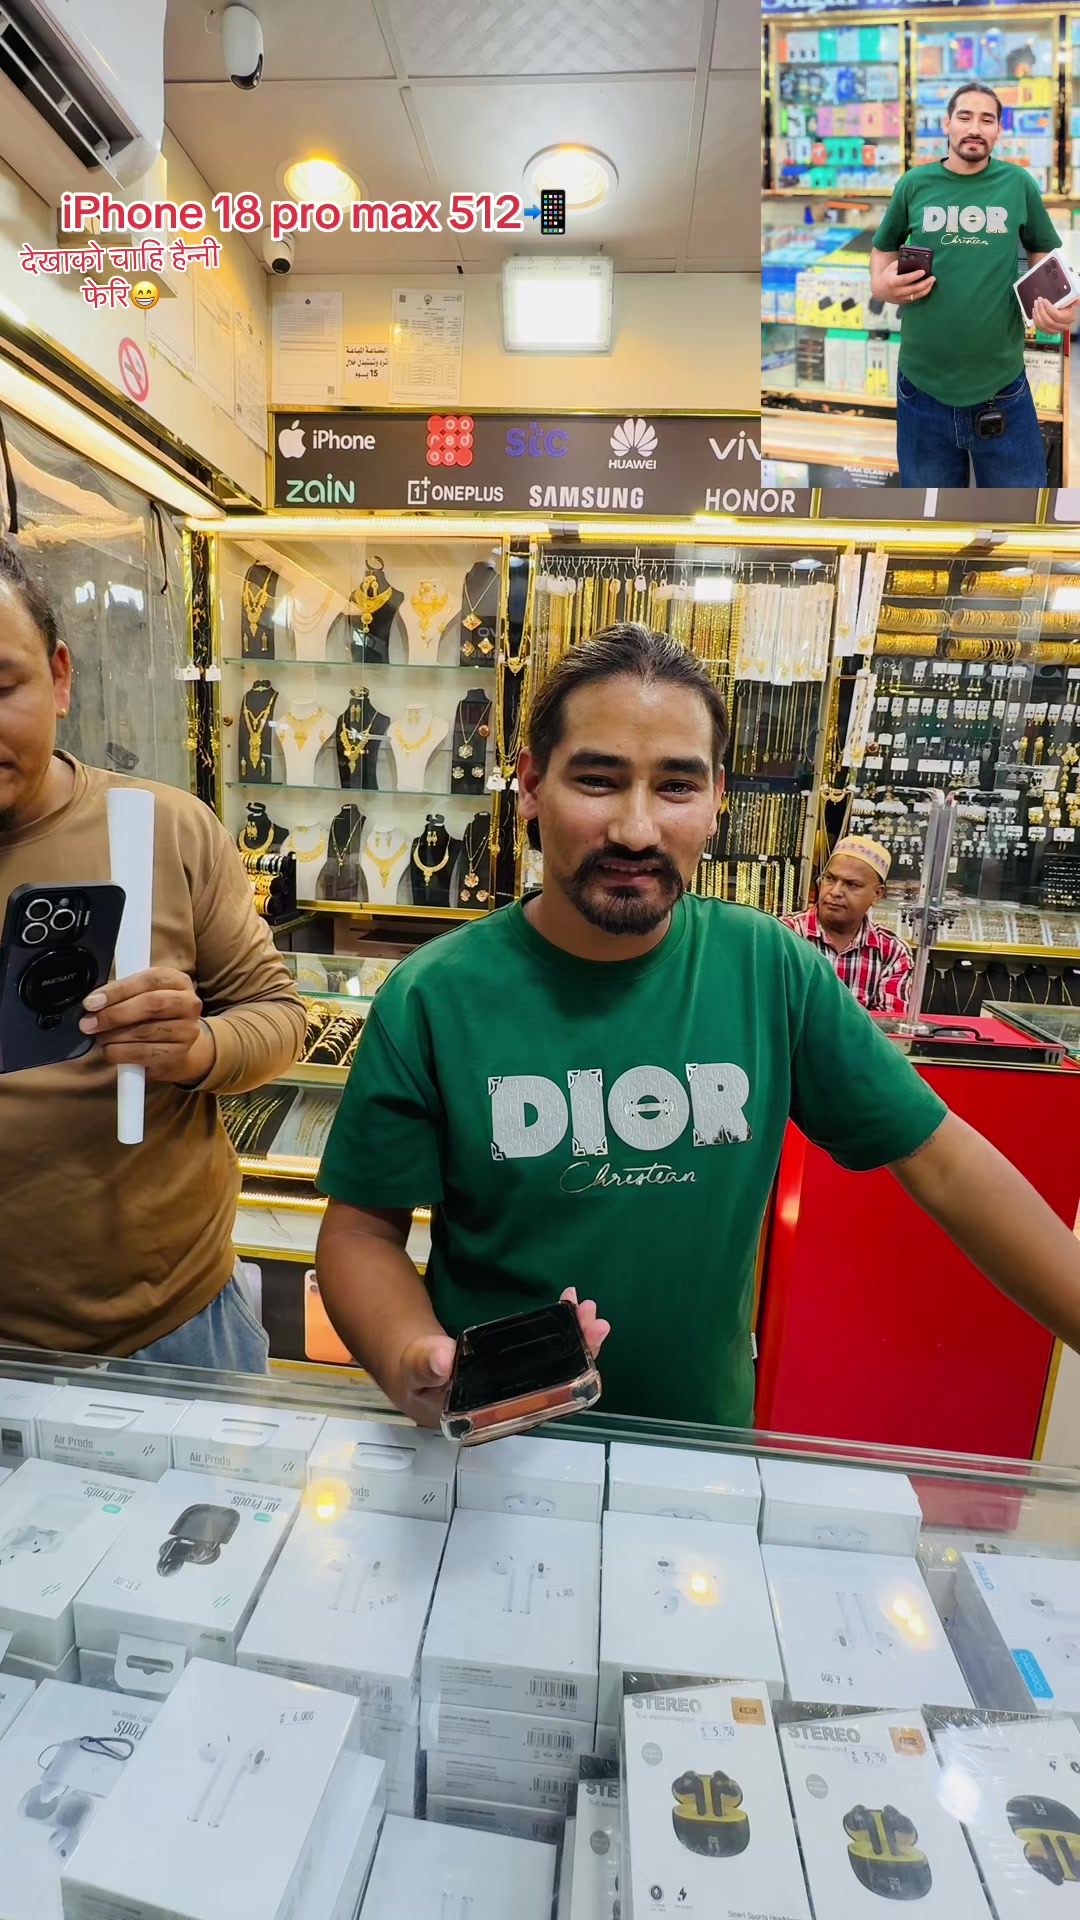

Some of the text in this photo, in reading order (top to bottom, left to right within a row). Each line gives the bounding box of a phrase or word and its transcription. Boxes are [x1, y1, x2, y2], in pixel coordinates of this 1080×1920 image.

[922, 205, 1008, 233] DIOR
[370, 369, 379, 377] 15
[312, 429, 376, 450] iPhone
[608, 459, 657, 470] HUAWEI
[431, 485, 504, 502] ONEPLUS
[529, 485, 645, 509] SAMSUNG
[704, 487, 796, 513] HONOR
[488, 1062, 753, 1161] DIOR
[54, 1434, 94, 1449] Air Prods
[189, 1452, 202, 1463] Air
[116, 1493, 132, 1505] Air
[263, 1501, 280, 1513] Air
[631, 1694, 702, 1713] STEREO
[292, 1711, 314, 1722] 6.000
[786, 1723, 861, 1744] STEREO
